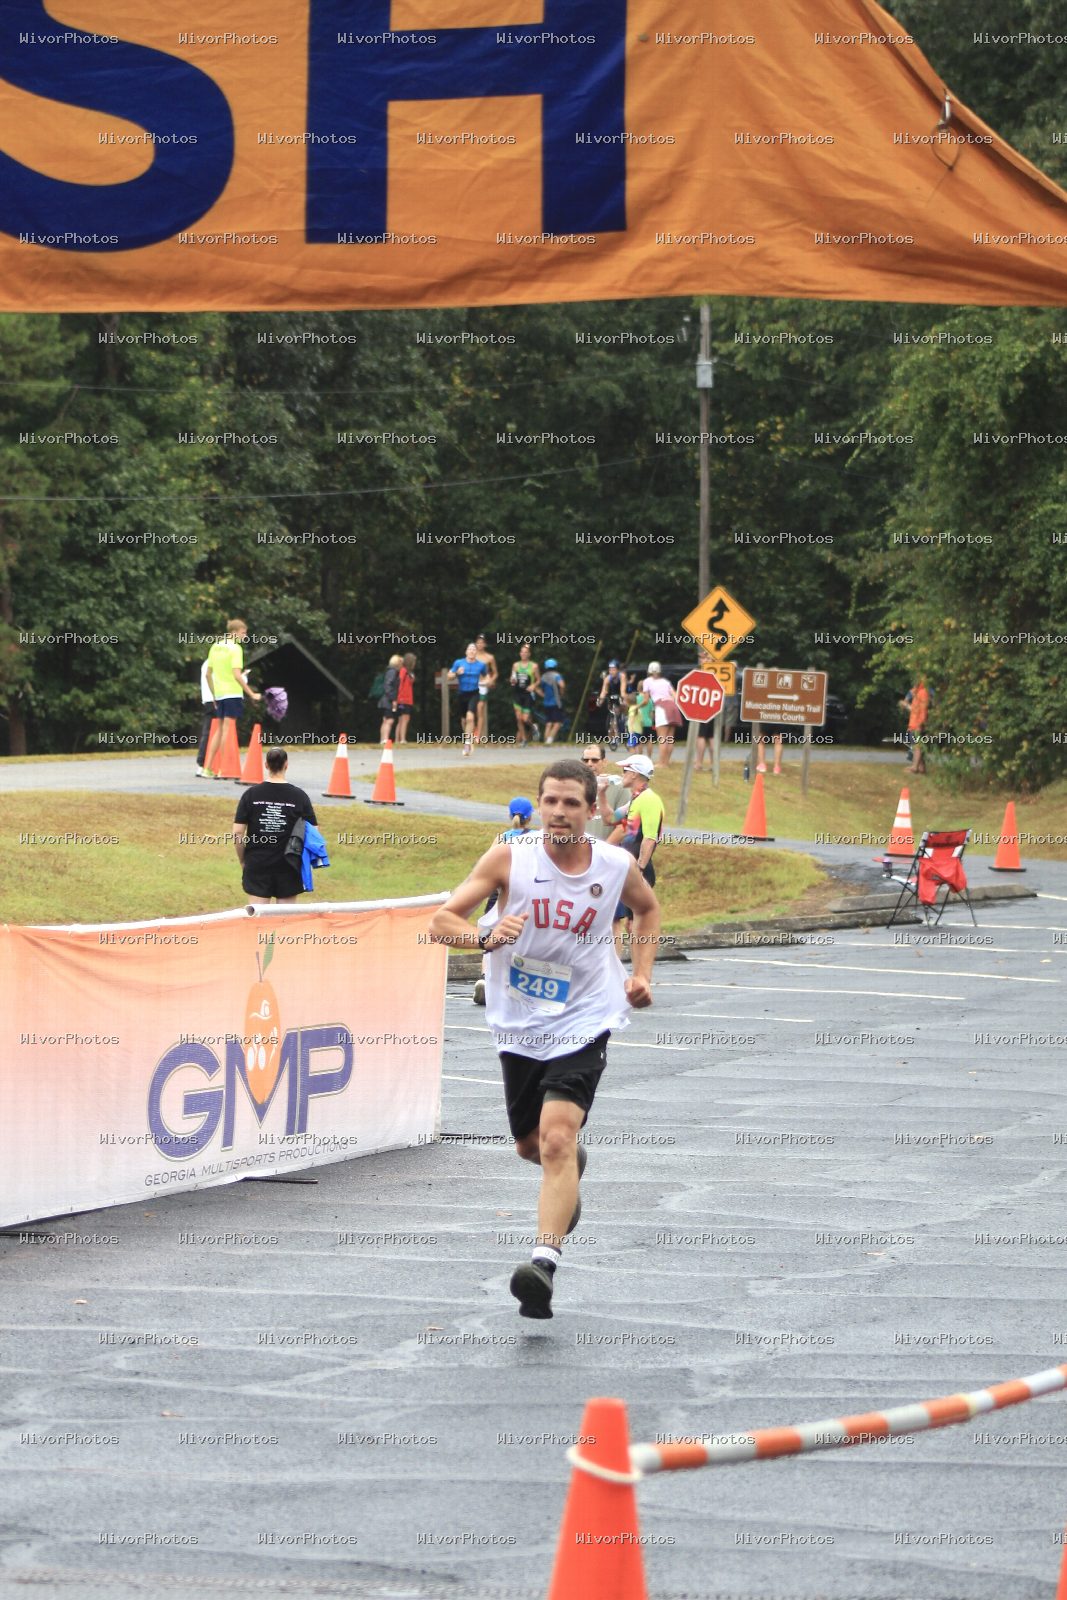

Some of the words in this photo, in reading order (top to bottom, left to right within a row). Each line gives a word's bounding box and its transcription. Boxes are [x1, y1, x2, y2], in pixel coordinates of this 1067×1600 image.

[679, 683, 722, 708] STOP
[782, 703, 805, 713] Nature
[806, 704, 821, 713] Trail
[759, 711, 781, 720] Tennis
[782, 712, 805, 722] Courts
[532, 897, 597, 938] USA
[517, 973, 559, 999] 249
[148, 1022, 354, 1163] GMP
[144, 1168, 197, 1187] GEORGIA
[201, 1152, 275, 1176] MULTISPORTS
[278, 1143, 349, 1160] PRODUCTIONS
